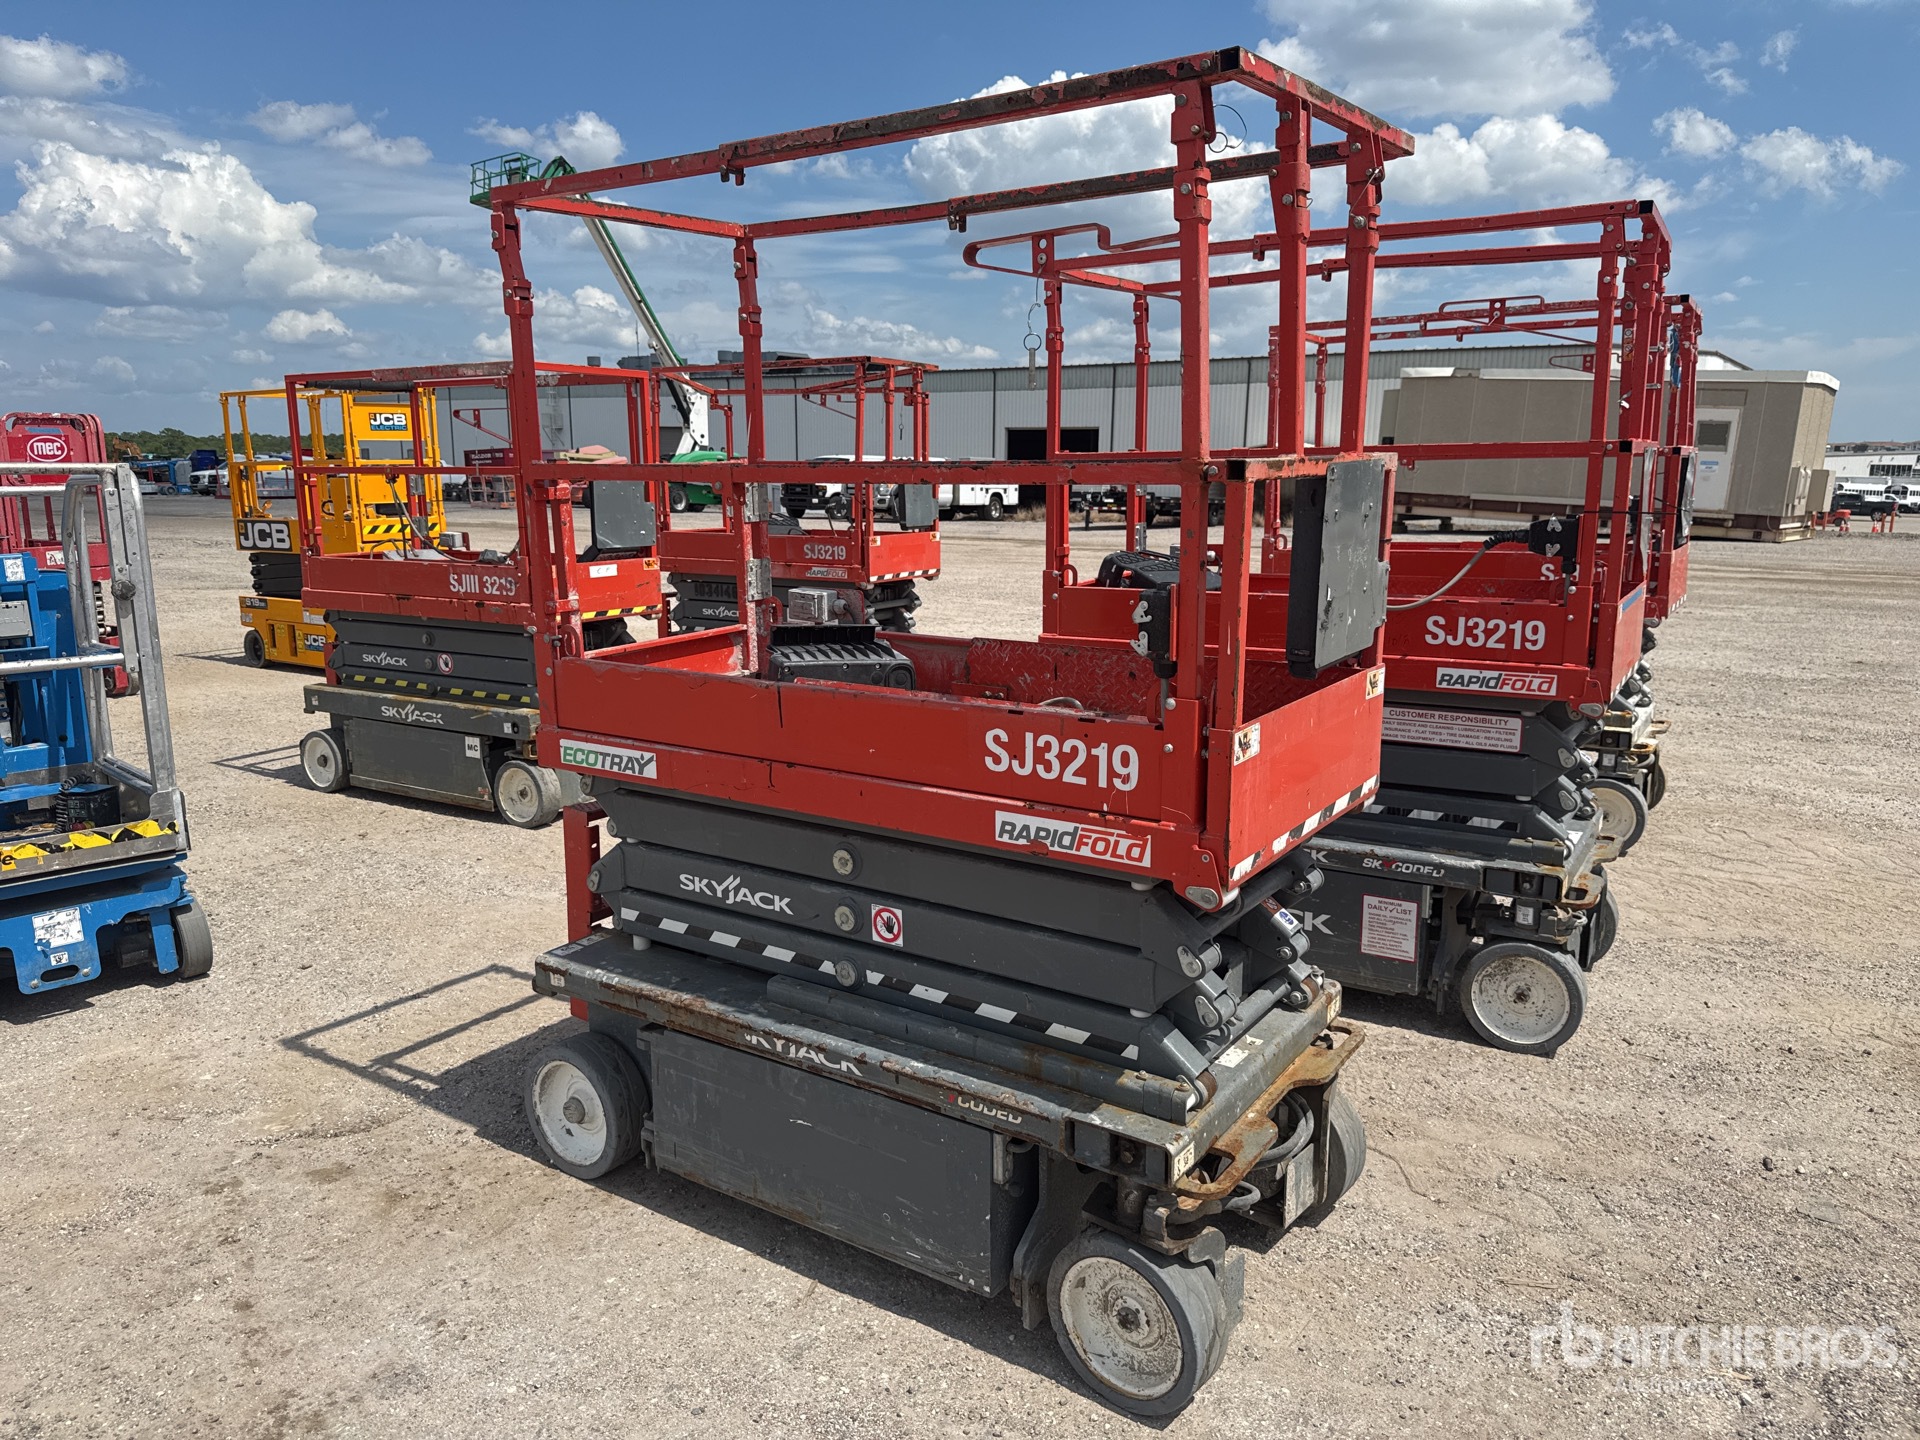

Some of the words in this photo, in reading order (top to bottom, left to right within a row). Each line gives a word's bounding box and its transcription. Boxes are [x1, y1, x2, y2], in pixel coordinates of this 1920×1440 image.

[370, 413, 406, 425] JCB
[33, 441, 61, 455] mec
[240, 522, 290, 549] JCB
[803, 544, 846, 560] SJ3219
[450, 574, 479, 593] SJIII
[702, 606, 739, 617] SKYJAC
[1425, 615, 1546, 651] SJ3219
[362, 652, 408, 667] SKYJACK
[381, 703, 445, 725] SKYJACK
[1389, 710, 1436, 720] CUSTOMER
[1438, 714, 1509, 726] RESPONSIBILITY
[467, 743, 478, 752] MC
[562, 746, 655, 775] ECOTRAY
[984, 728, 1139, 791] SJ3219
[679, 873, 794, 916] SKYJACK
[1368, 903, 1388, 911] DAILY
[1396, 907, 1412, 915] LIST
